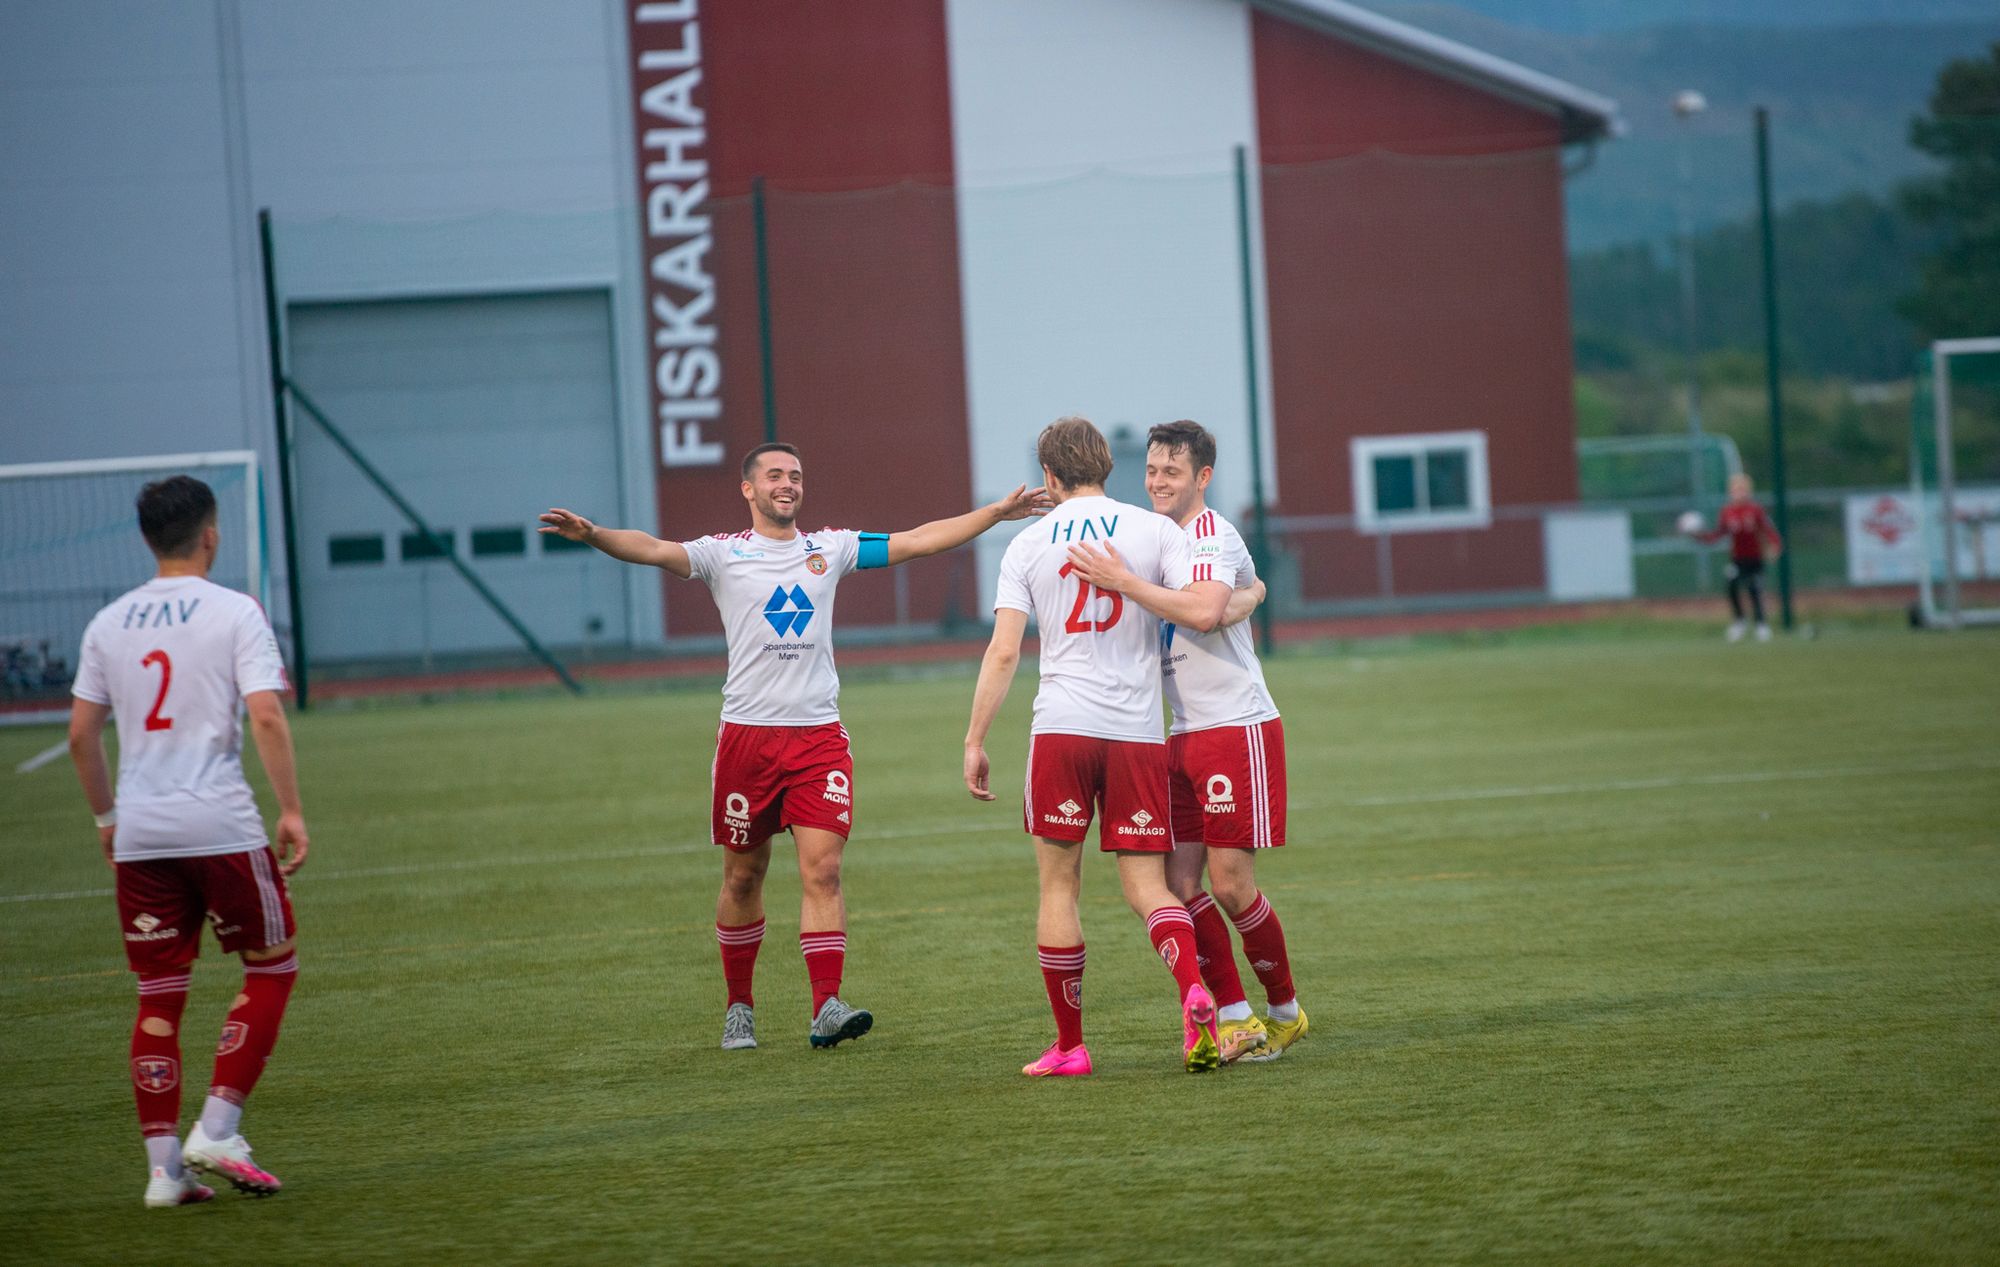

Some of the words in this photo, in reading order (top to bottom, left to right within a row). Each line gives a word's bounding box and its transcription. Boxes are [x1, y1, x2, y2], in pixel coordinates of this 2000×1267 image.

[1052, 515, 1118, 544] HAV
[123, 598, 200, 629] HAV
[762, 642, 815, 652] Sparebanken
[778, 652, 800, 661] Møre
[140, 649, 174, 731] 2
[730, 827, 750, 845] 22
[1118, 826, 1166, 836] SMARAGD
